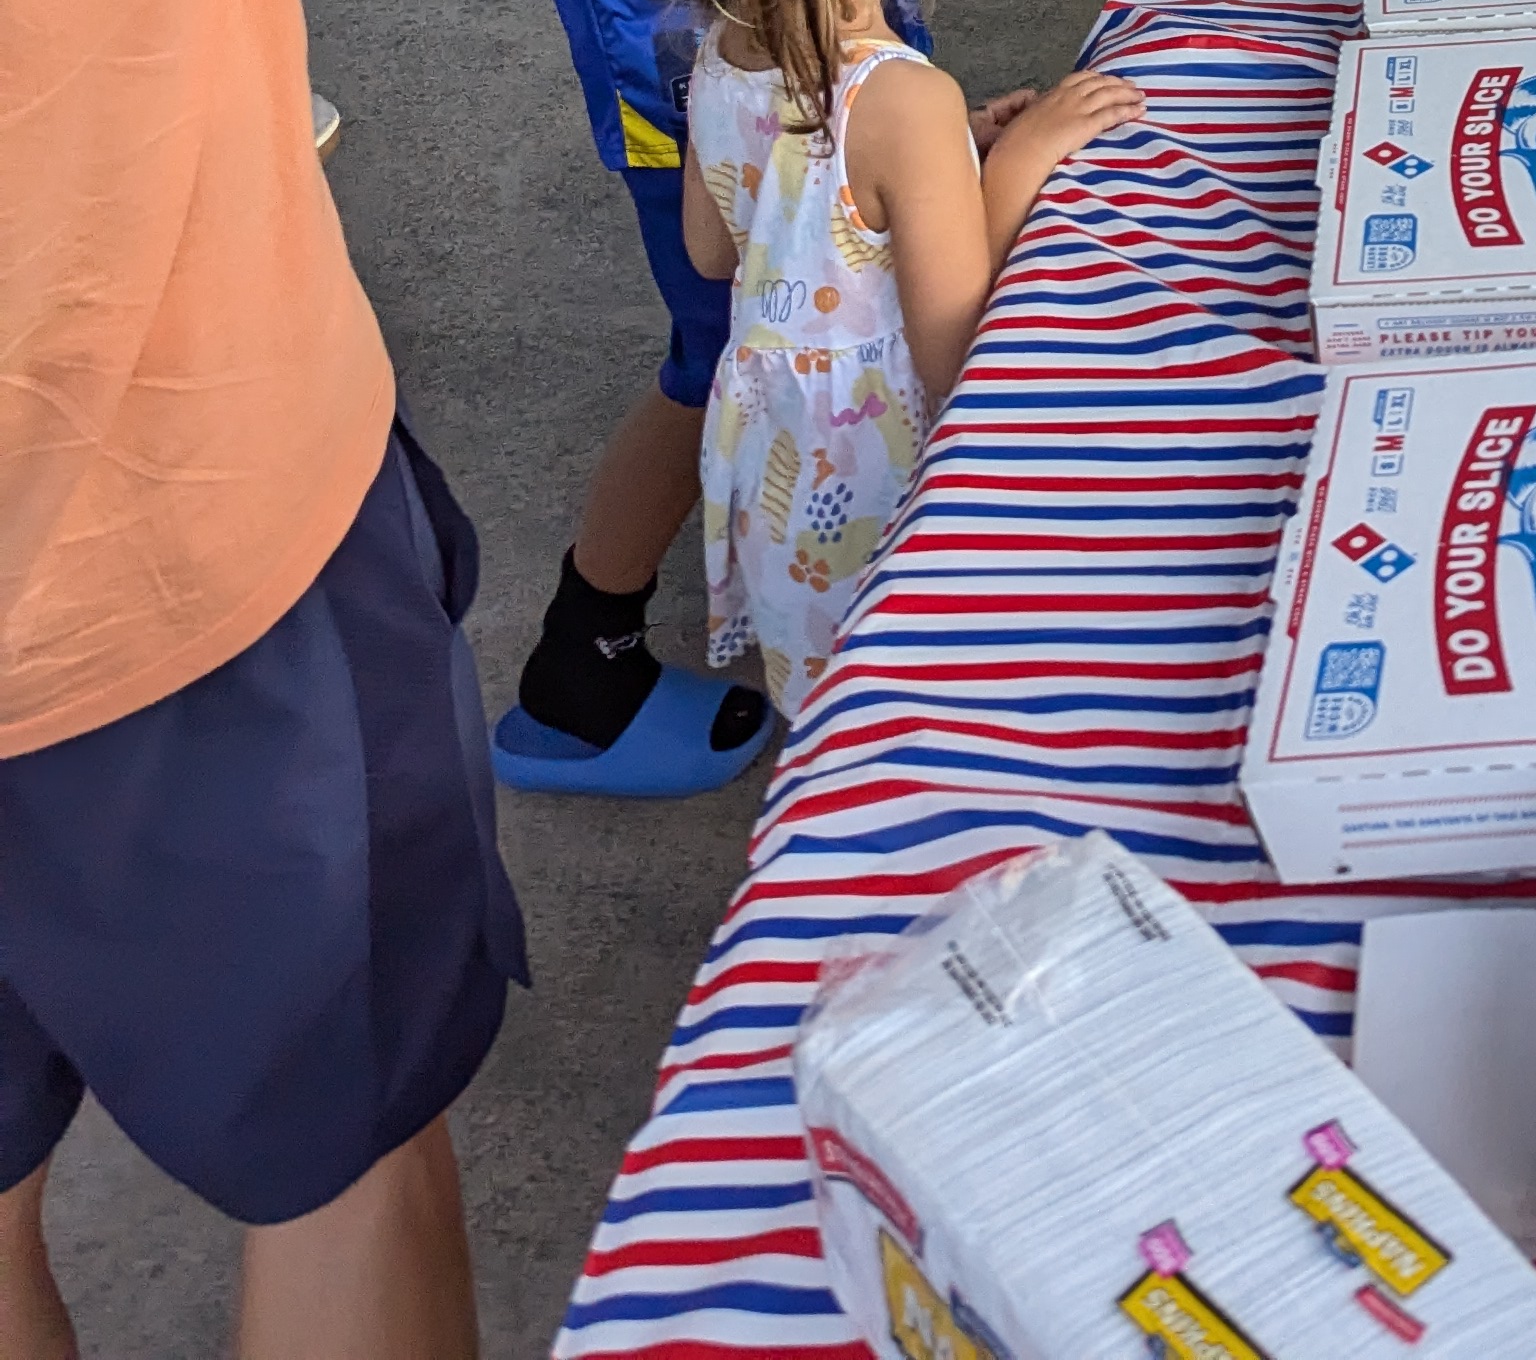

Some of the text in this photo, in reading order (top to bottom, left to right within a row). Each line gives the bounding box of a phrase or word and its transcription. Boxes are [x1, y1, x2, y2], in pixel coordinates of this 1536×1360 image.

[1460, 73, 1511, 239] DO YOUR SLICE
[1379, 330, 1452, 344] PLEASE
[1462, 329, 1494, 340] TIP
[1373, 434, 1405, 451] M
[1444, 415, 1525, 682] DO YOUR SLICE
[1309, 1178, 1426, 1278] NAPKINS
